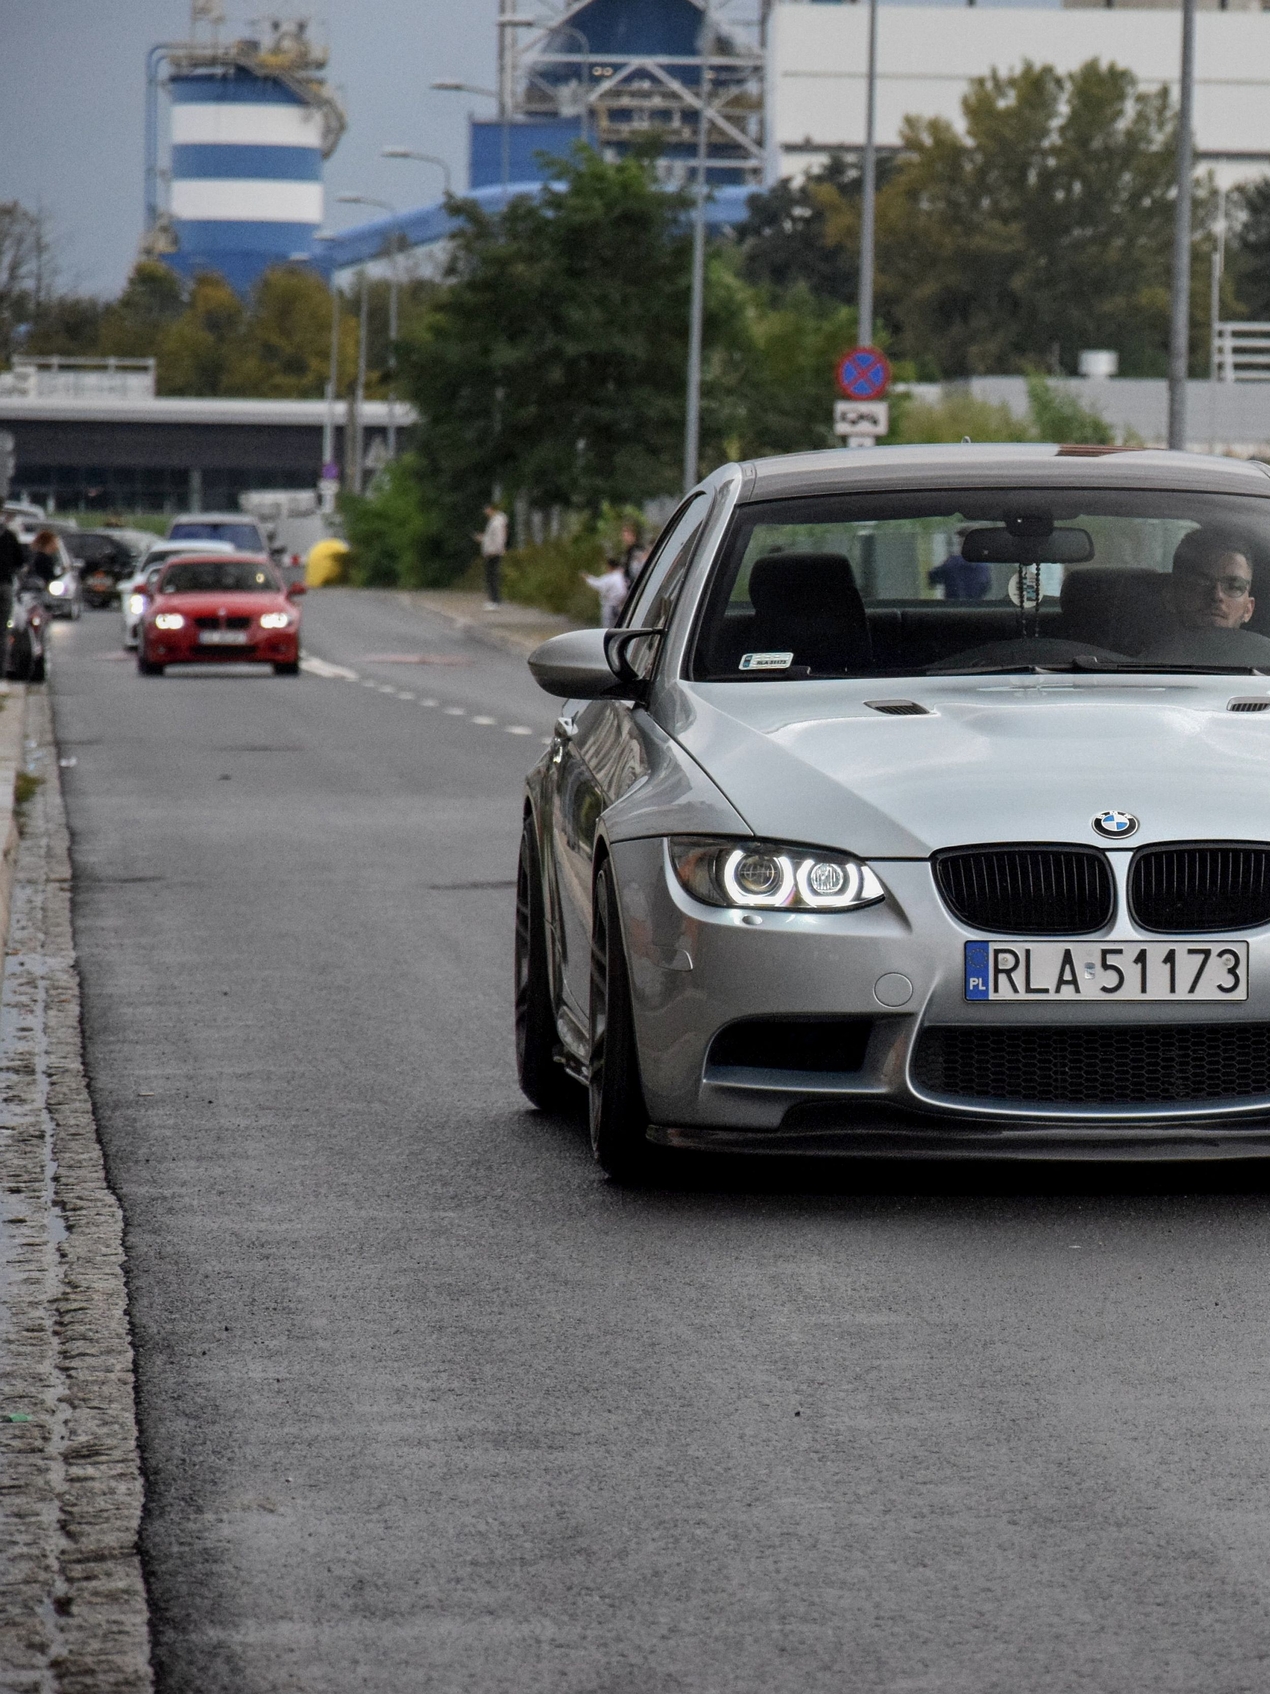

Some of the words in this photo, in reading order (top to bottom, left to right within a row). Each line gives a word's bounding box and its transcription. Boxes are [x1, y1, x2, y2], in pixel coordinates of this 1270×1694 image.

[969, 977, 986, 990] PL
[993, 948, 1081, 994] RLA
[1100, 948, 1241, 994] 51173
